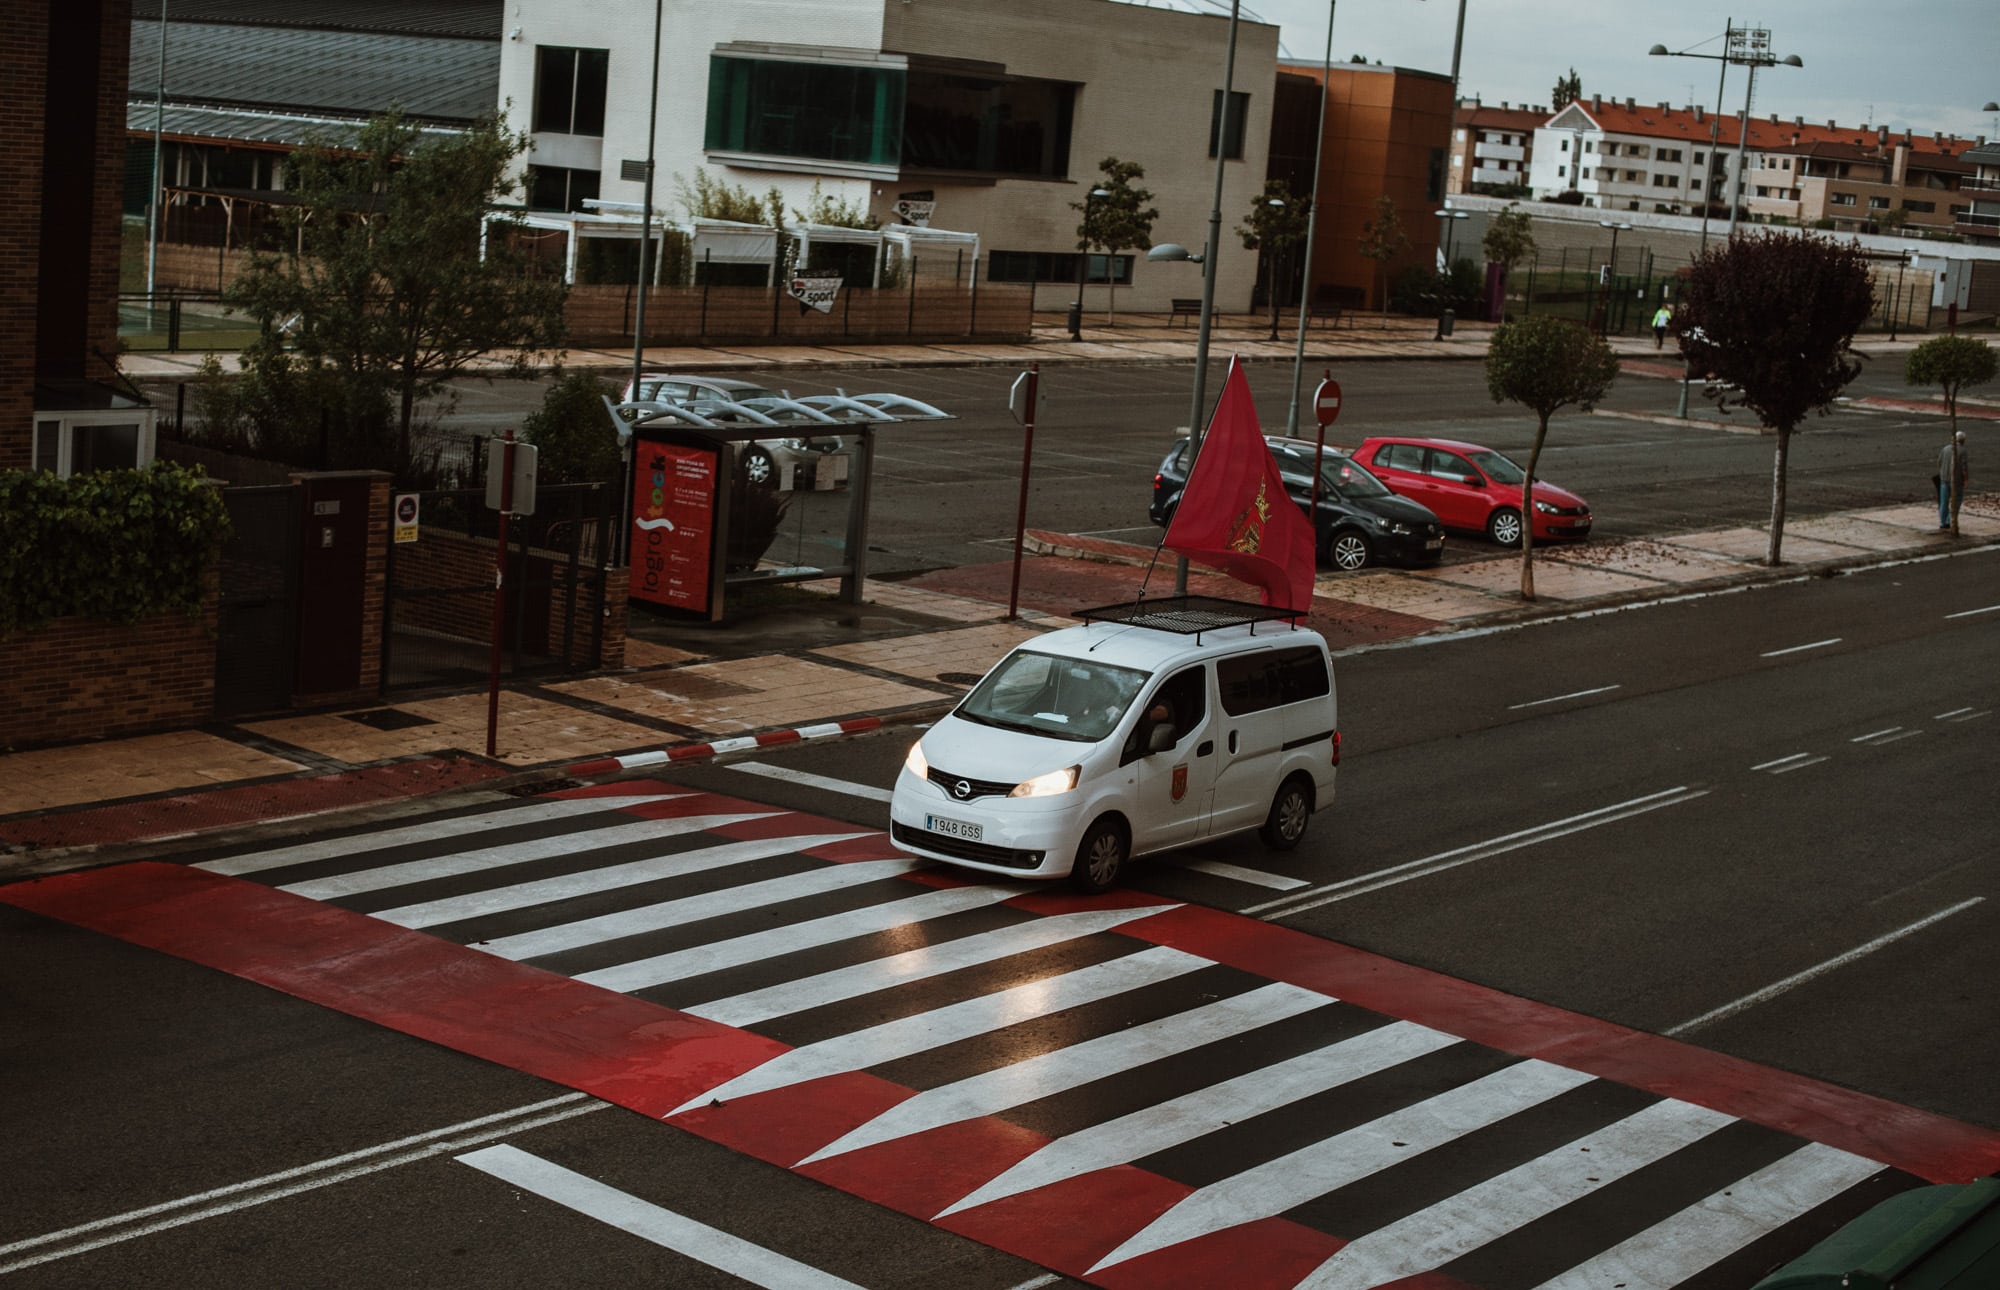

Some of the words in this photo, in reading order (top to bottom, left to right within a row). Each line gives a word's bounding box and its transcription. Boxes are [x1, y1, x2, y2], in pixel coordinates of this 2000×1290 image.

[910, 211, 930, 221] sport
[807, 290, 834, 306] sport
[934, 819, 958, 834] 1948
[961, 825, 980, 839] GSS
